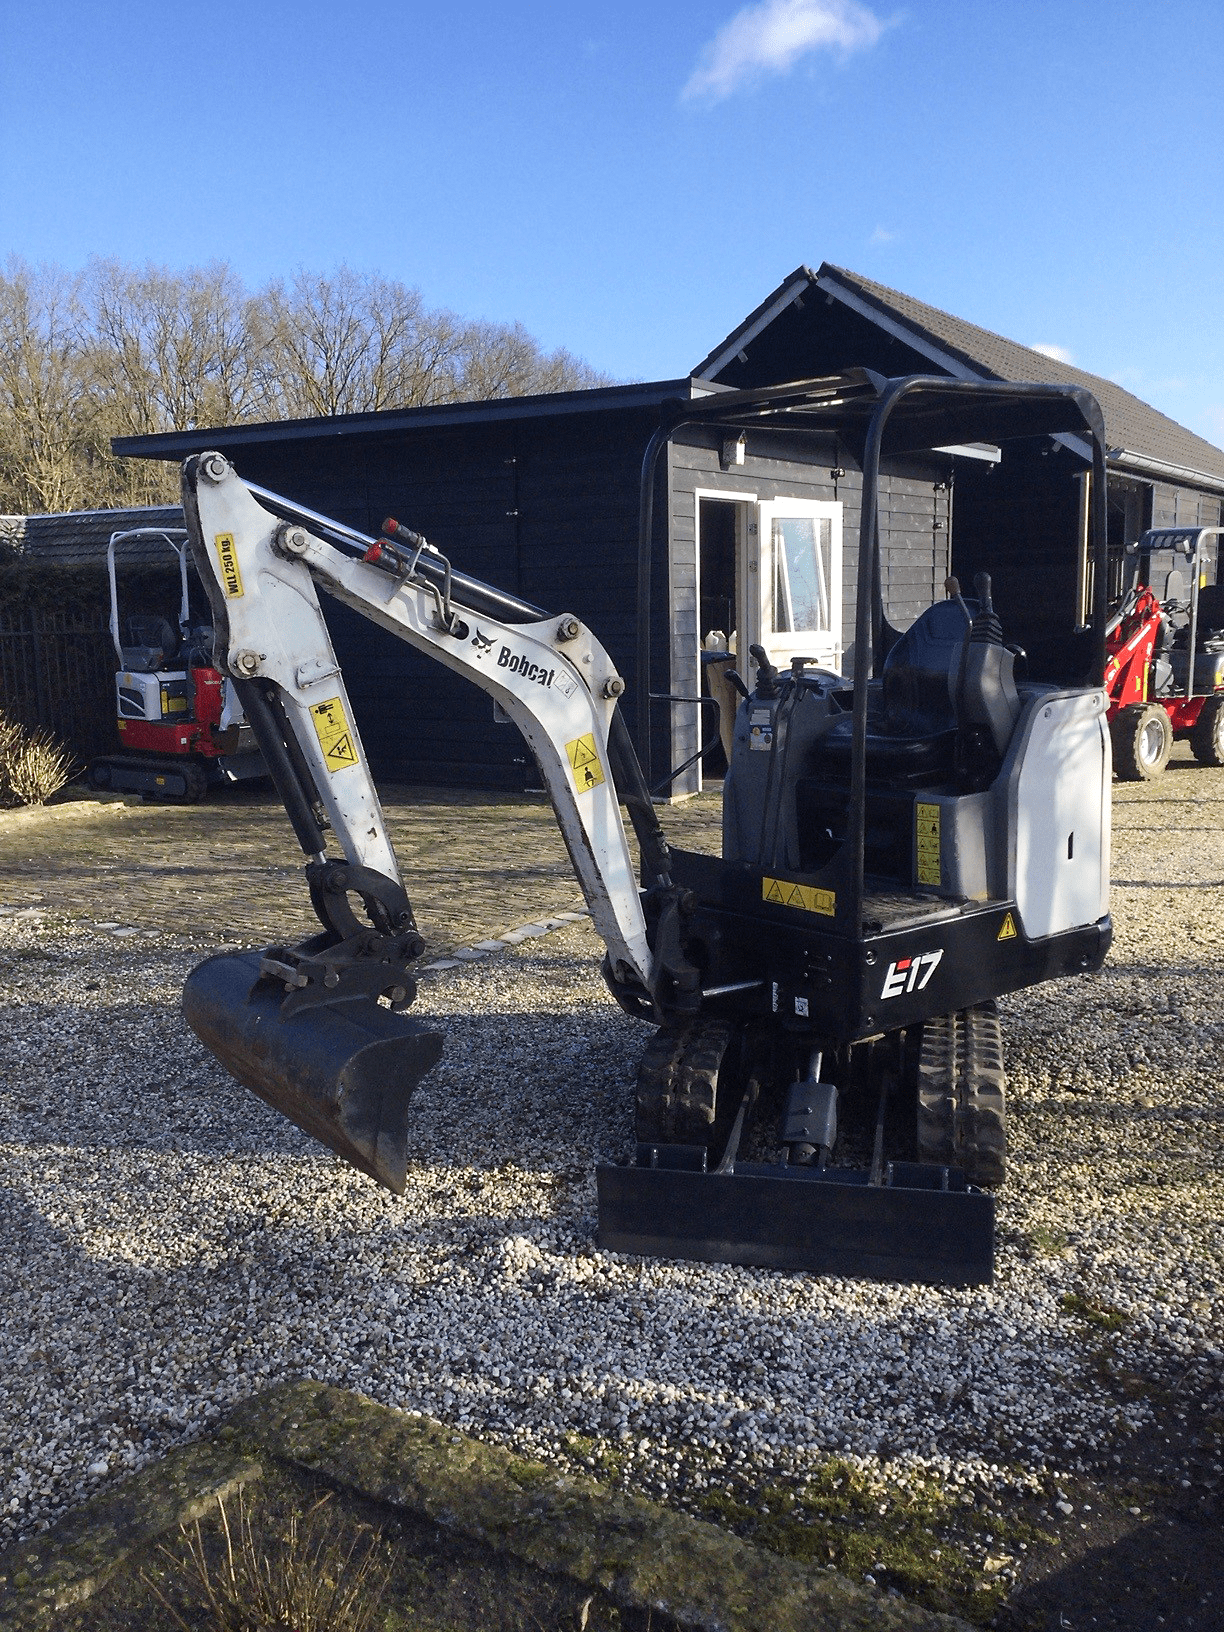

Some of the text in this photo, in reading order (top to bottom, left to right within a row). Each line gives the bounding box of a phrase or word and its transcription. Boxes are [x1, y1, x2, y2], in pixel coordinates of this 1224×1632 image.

[222, 554, 235, 574] 250
[227, 575, 239, 594] WLL
[497, 645, 555, 689] Bobcat
[880, 949, 944, 1000] E17
